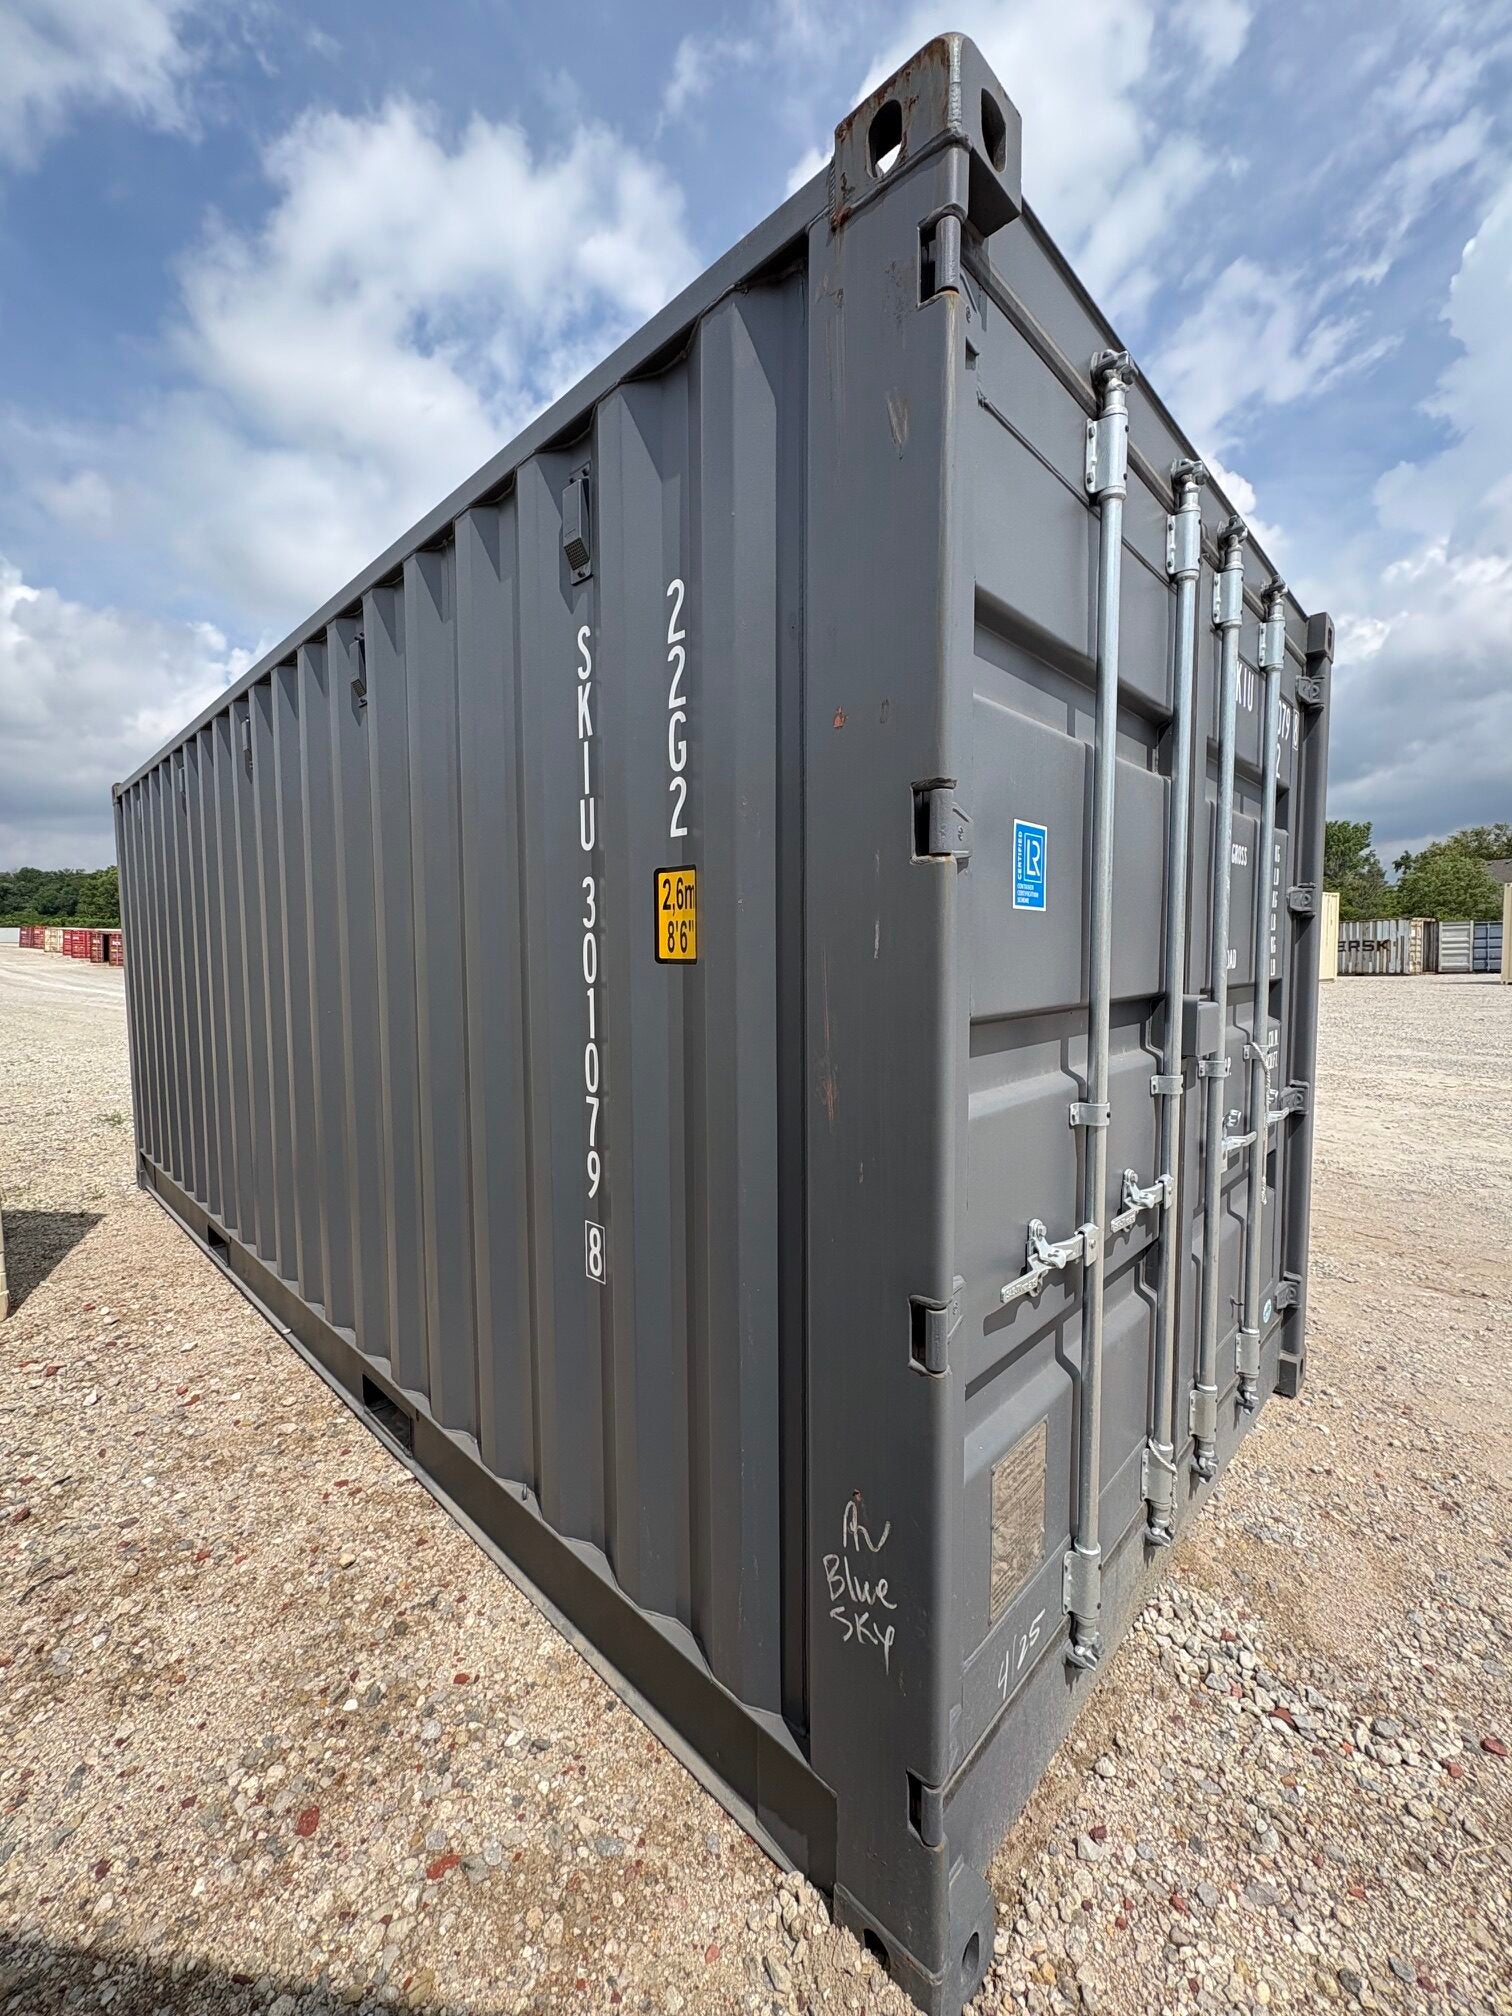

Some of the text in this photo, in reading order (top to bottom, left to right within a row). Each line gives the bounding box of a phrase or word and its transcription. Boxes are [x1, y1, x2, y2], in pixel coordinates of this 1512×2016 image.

[666, 578, 688, 838] 22G2
[1235, 660, 1254, 712] KIU
[662, 877, 695, 916] 2,6m
[577, 625, 603, 1278] SKIU 301079 8
[667, 920, 695, 954] 8'6"
[1337, 938, 1391, 952] ERSK
[822, 1554, 898, 1610] Blue
